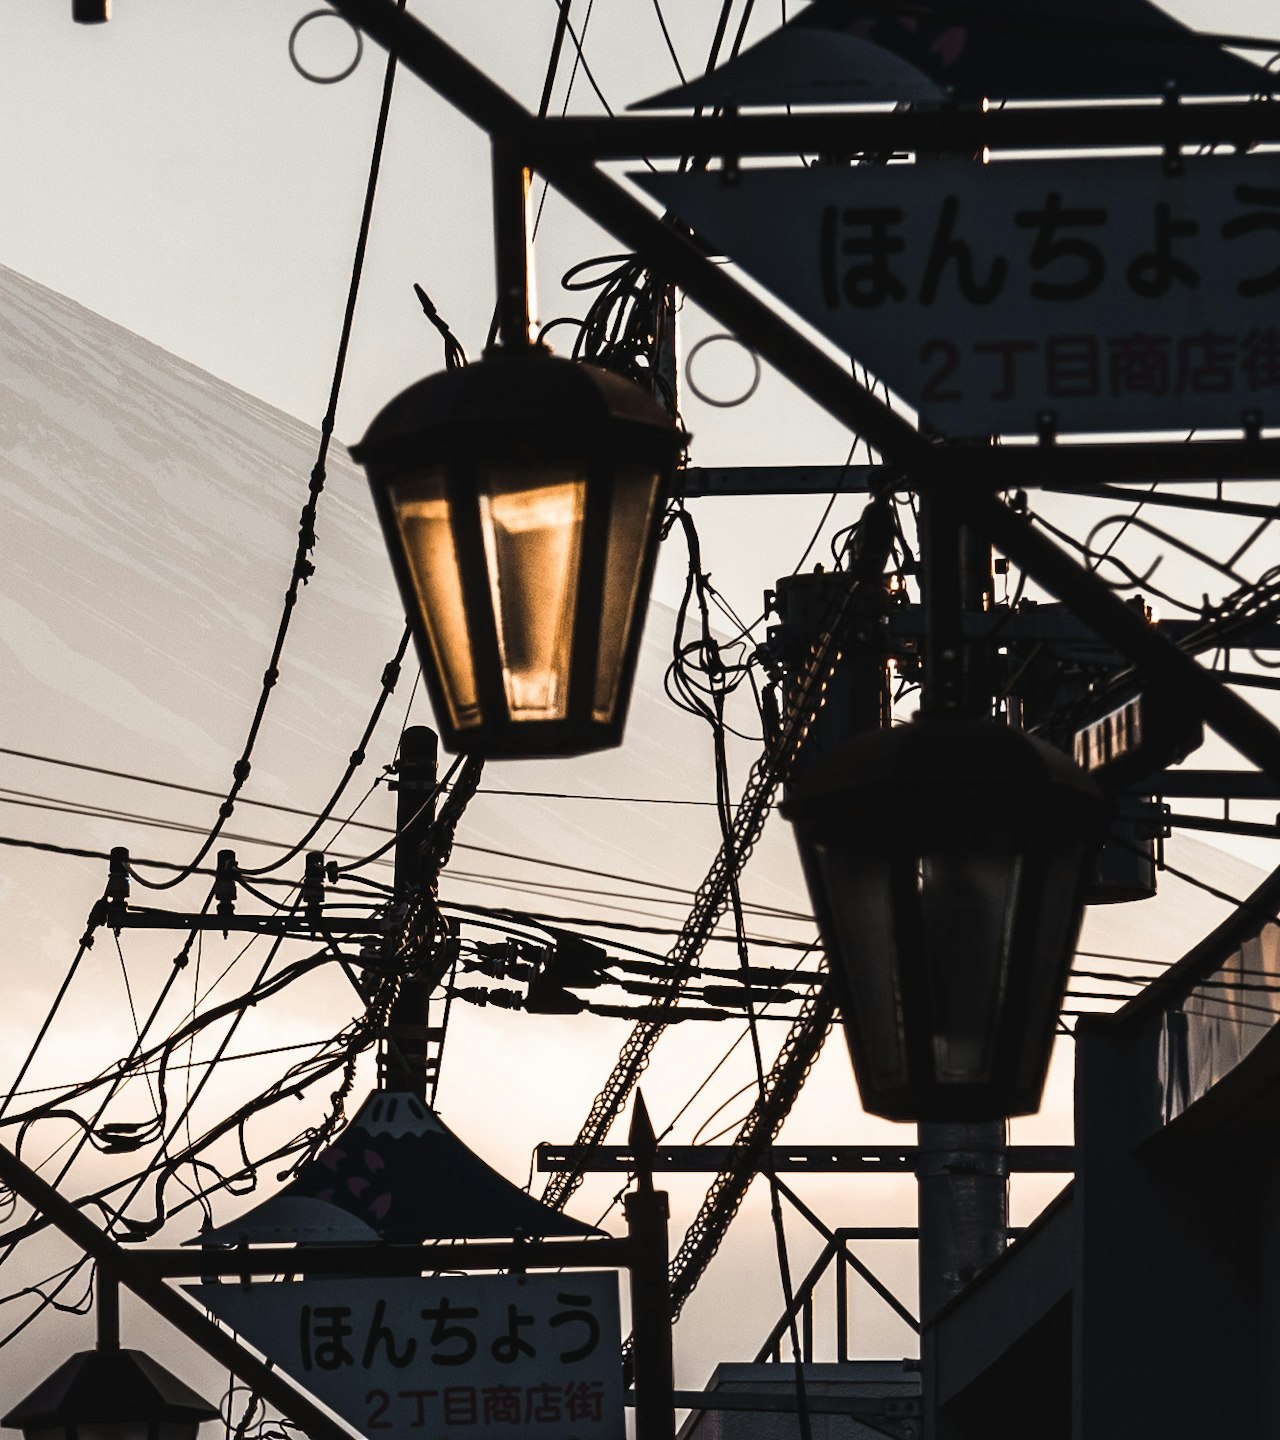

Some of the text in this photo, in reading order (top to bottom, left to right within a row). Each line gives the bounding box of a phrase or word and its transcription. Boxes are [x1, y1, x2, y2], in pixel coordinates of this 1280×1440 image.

[820, 185, 1280, 311] ほんちょう
[298, 1290, 602, 1372] ほんちょう
[364, 1380, 605, 1431] 2丁目商店街
